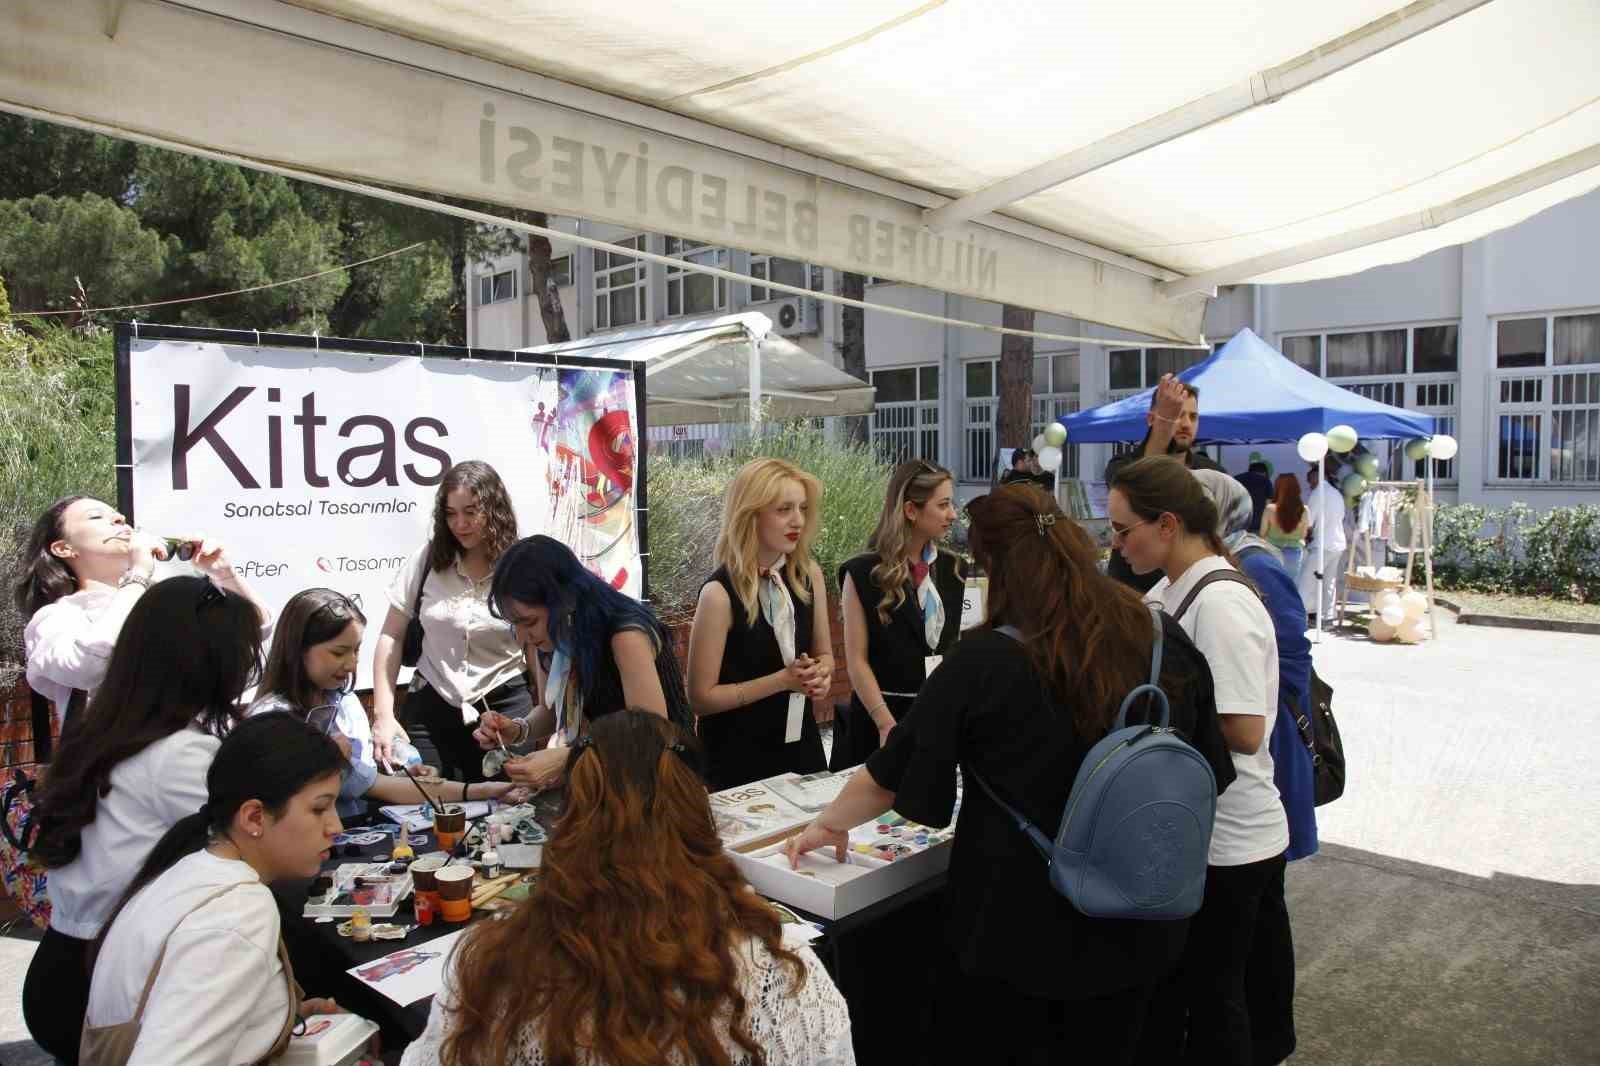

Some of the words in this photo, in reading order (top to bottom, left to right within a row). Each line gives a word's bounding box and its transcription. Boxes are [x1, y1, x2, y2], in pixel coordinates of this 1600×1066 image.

[172, 384, 453, 490] Kitas
[223, 500, 313, 518] Sanatsal
[319, 498, 417, 516] Tasarımlar
